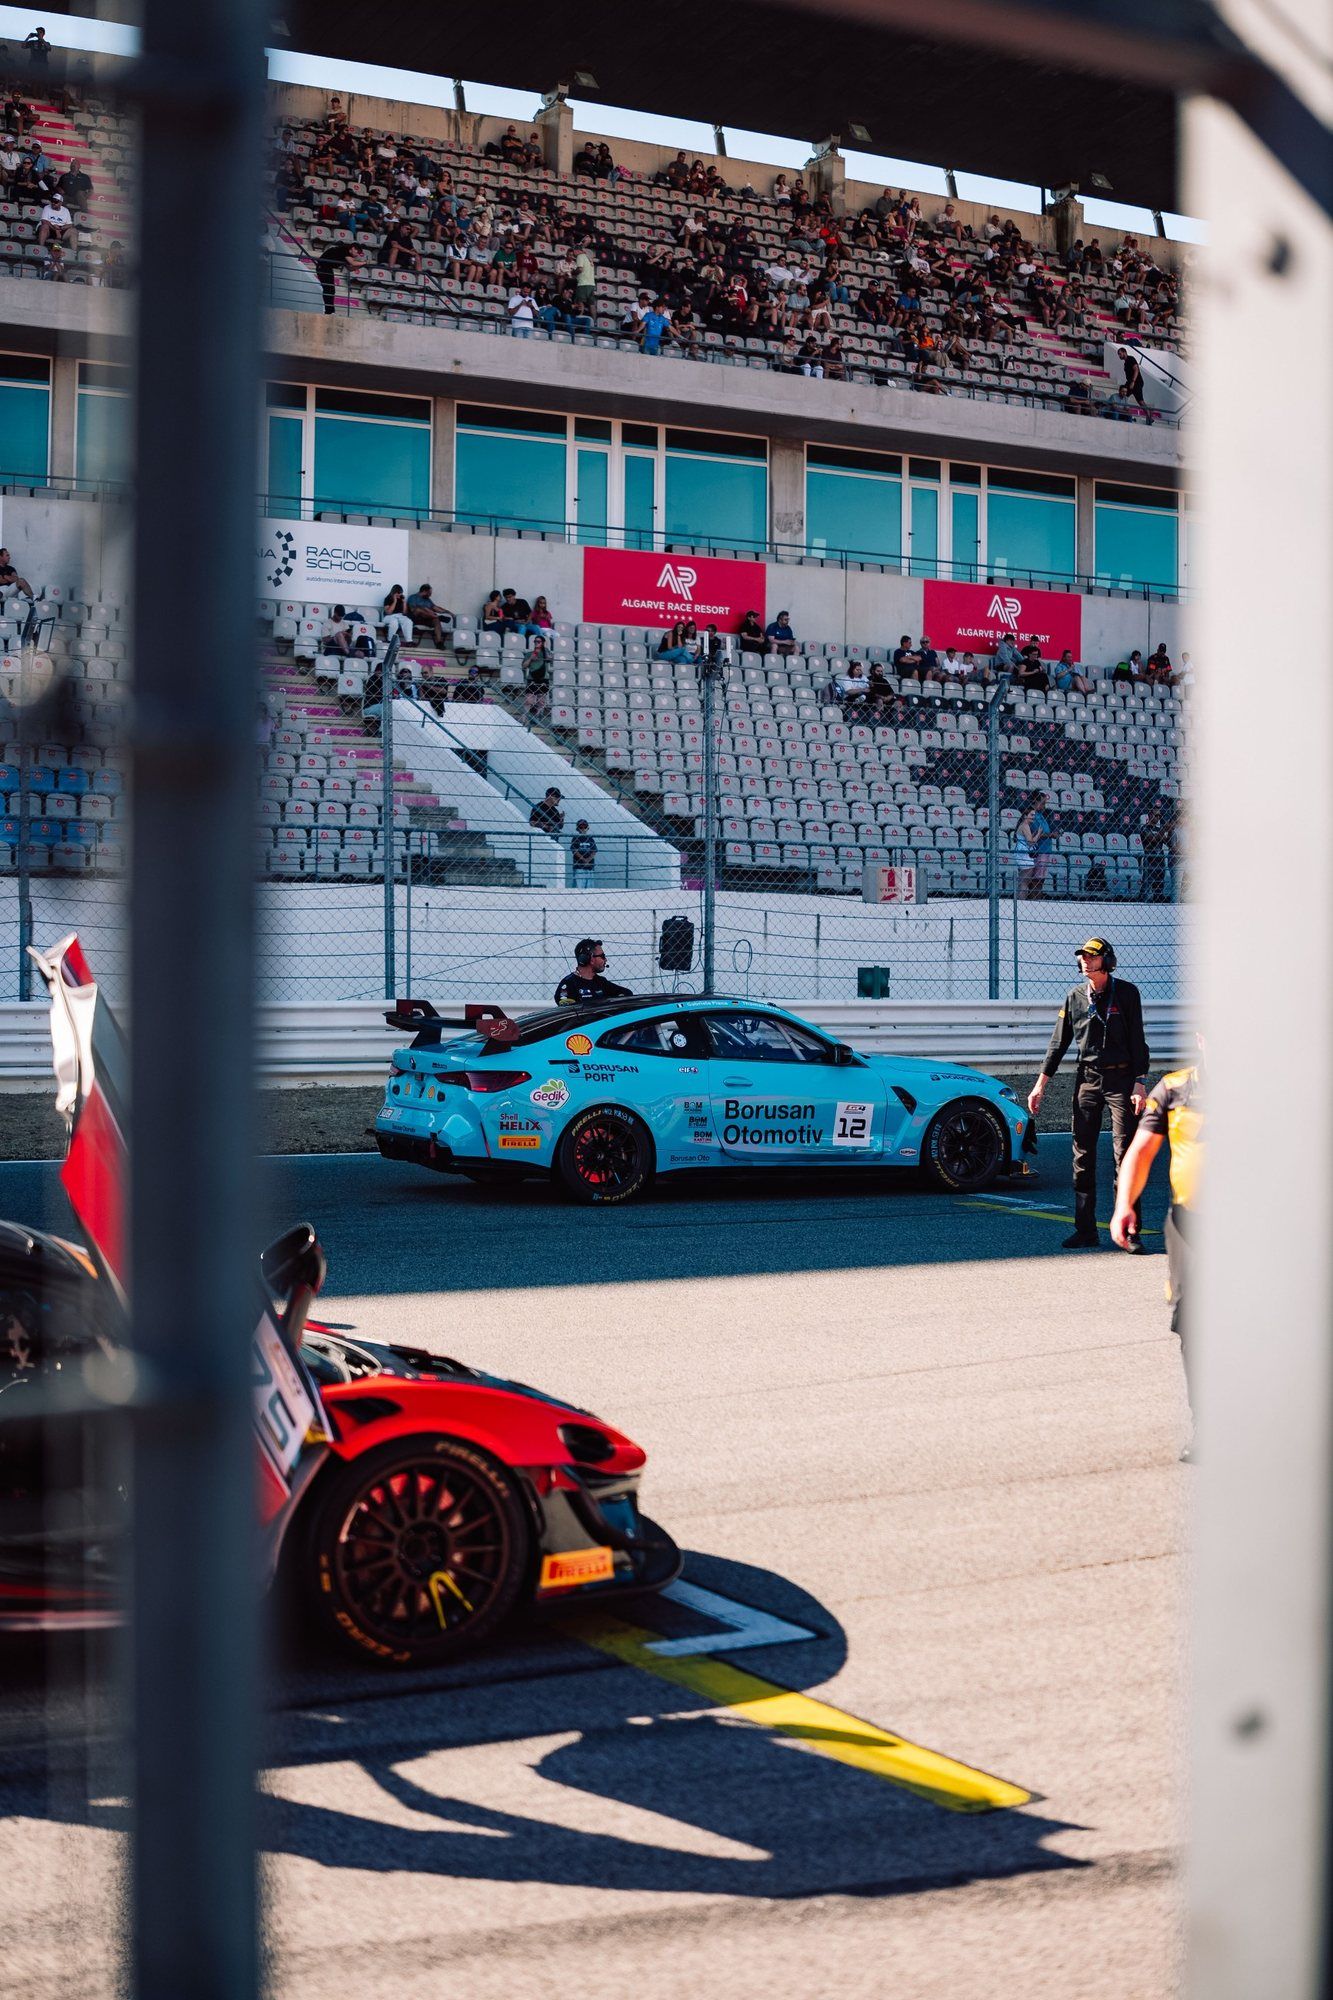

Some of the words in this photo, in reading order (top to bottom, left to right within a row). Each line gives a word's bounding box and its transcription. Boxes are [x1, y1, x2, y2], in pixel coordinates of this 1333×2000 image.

[306, 546, 371, 561] RACING
[306, 558, 382, 574] SCHOOL
[621, 598, 665, 610] ALGARVE
[667, 602, 692, 613] RACE
[694, 604, 731, 616] RESORT
[957, 627, 994, 639] ALGARVE
[996, 630, 1017, 641] RAE
[1019, 632, 1050, 643] RERT
[582, 1063, 640, 1074] BORUSAN
[584, 1073, 616, 1082] PORT
[532, 1090, 566, 1102] Gedik
[500, 1113, 519, 1121] Shell
[724, 1100, 816, 1120] Borusan
[500, 1117, 543, 1131] HELIX
[571, 1109, 602, 1138] PIRELLI
[837, 1117, 866, 1139] 12
[501, 1137, 537, 1147] PIRELLI
[723, 1124, 823, 1145] Otomotiv
[548, 1561, 609, 1579] PIRELLI
